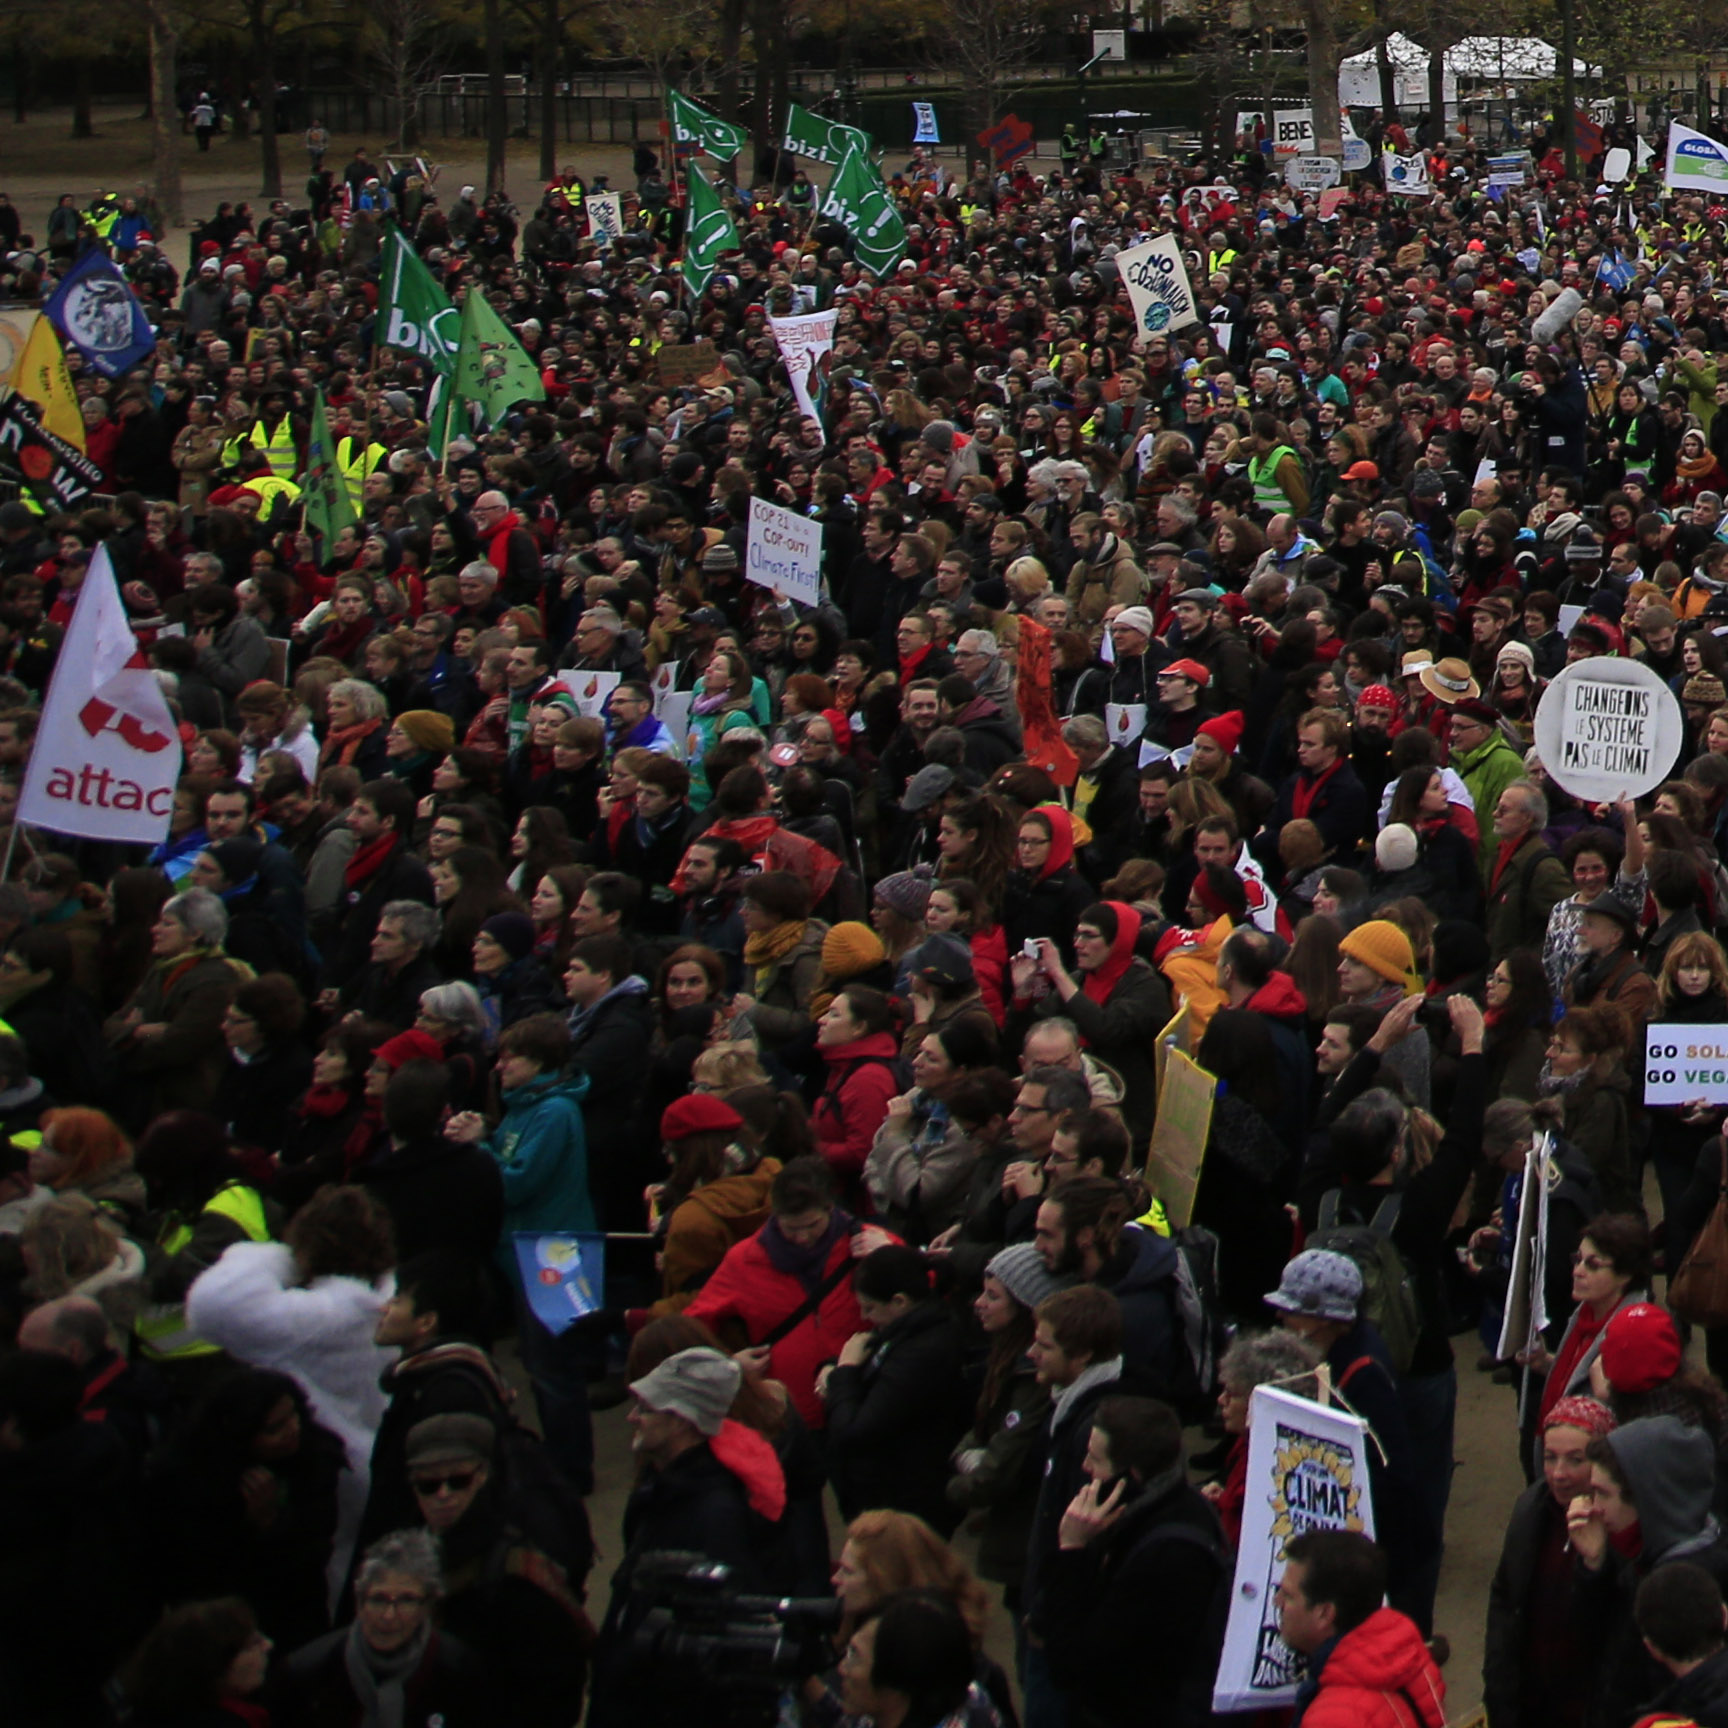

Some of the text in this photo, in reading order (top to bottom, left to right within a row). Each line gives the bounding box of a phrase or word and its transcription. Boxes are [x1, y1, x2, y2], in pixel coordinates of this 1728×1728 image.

[784, 135, 829, 163] bizi
[1147, 254, 1174, 274] NO
[754, 503, 774, 523] COP
[778, 513, 789, 530] 21
[1575, 685, 1650, 717] CHANGEONS
[1576, 718, 1585, 736] LE
[1564, 741, 1650, 775] PAS LE CLIMAT
[46, 762, 172, 817] attac
[1648, 1044, 1678, 1059] GO
[1647, 1069, 1676, 1084] GO
[1283, 1470, 1350, 1520] CLIMAT
